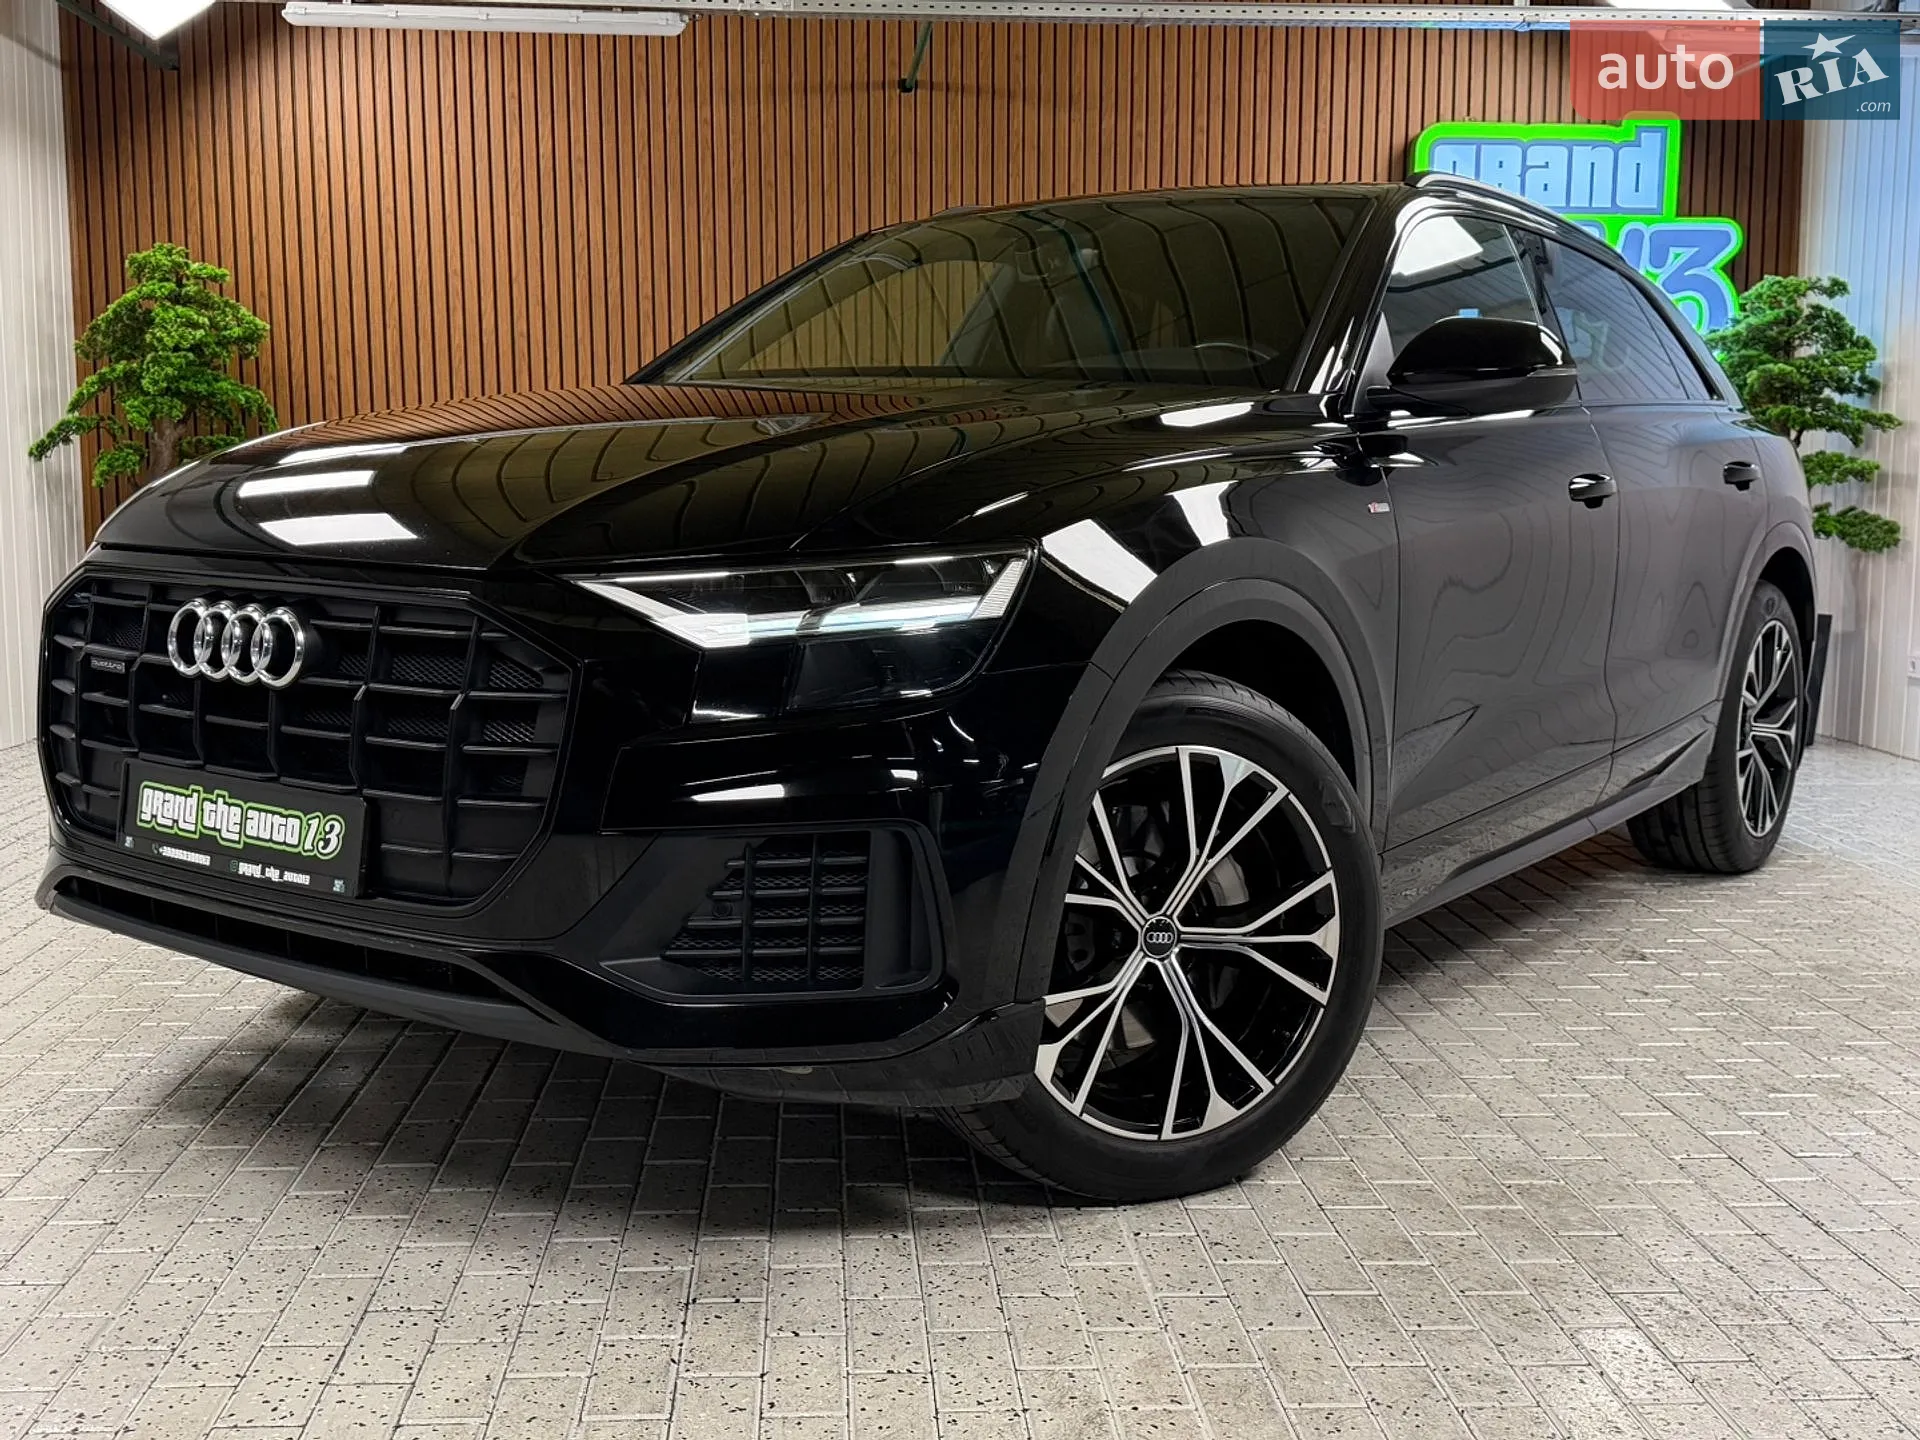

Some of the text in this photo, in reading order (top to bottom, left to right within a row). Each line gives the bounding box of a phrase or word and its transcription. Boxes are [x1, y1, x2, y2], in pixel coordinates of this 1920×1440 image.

[202, 797, 242, 841] the
[245, 810, 301, 845] auto
[304, 817, 342, 854] 13
